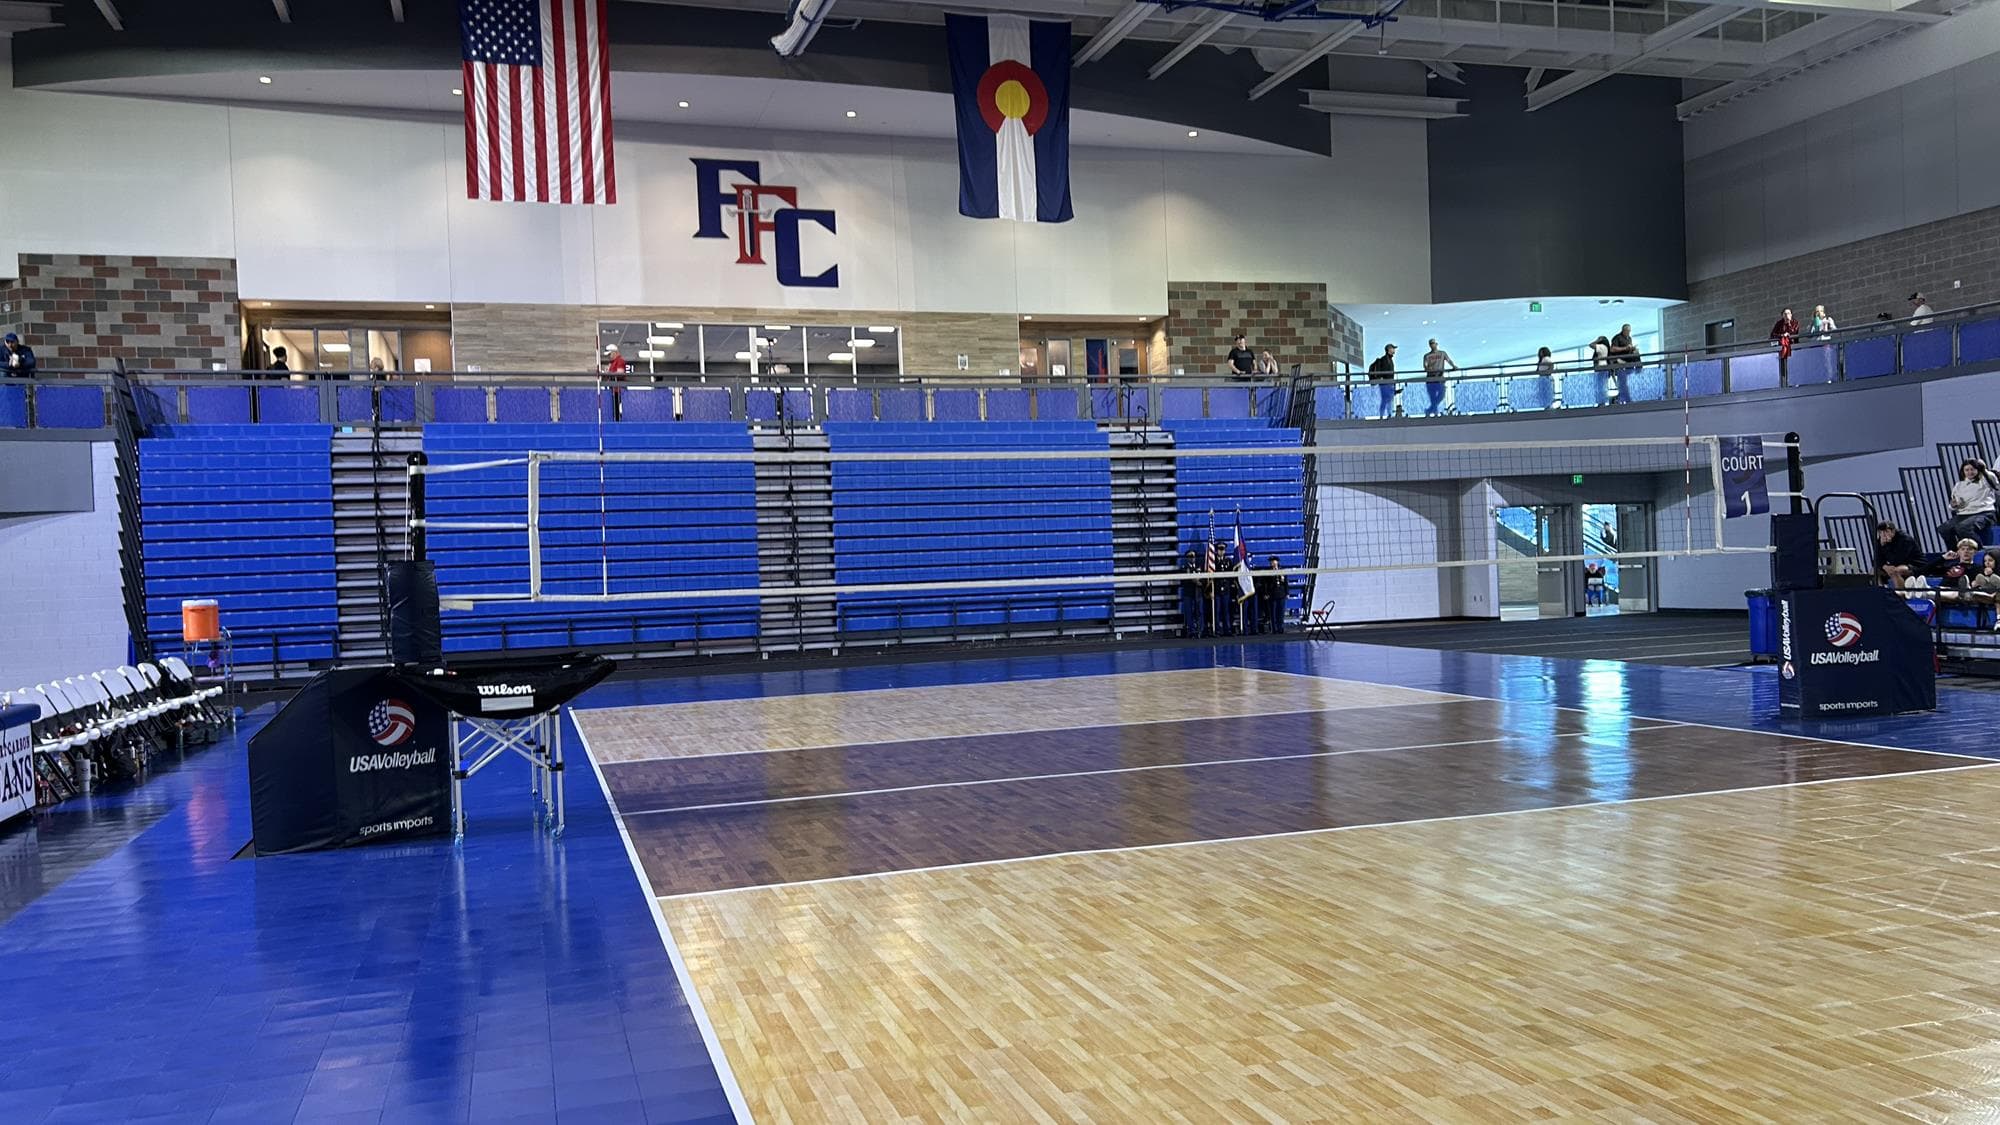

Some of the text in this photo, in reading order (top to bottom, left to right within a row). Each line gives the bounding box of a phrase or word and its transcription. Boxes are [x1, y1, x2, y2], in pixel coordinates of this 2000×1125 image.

[1722, 455, 1763, 472] COURT
[1741, 490, 1752, 515] 1
[1811, 649, 1879, 665] USAVolleyball
[1819, 700, 1878, 711] sports imports
[350, 747, 436, 772] USAVolleyball
[359, 816, 433, 836] sports imports
